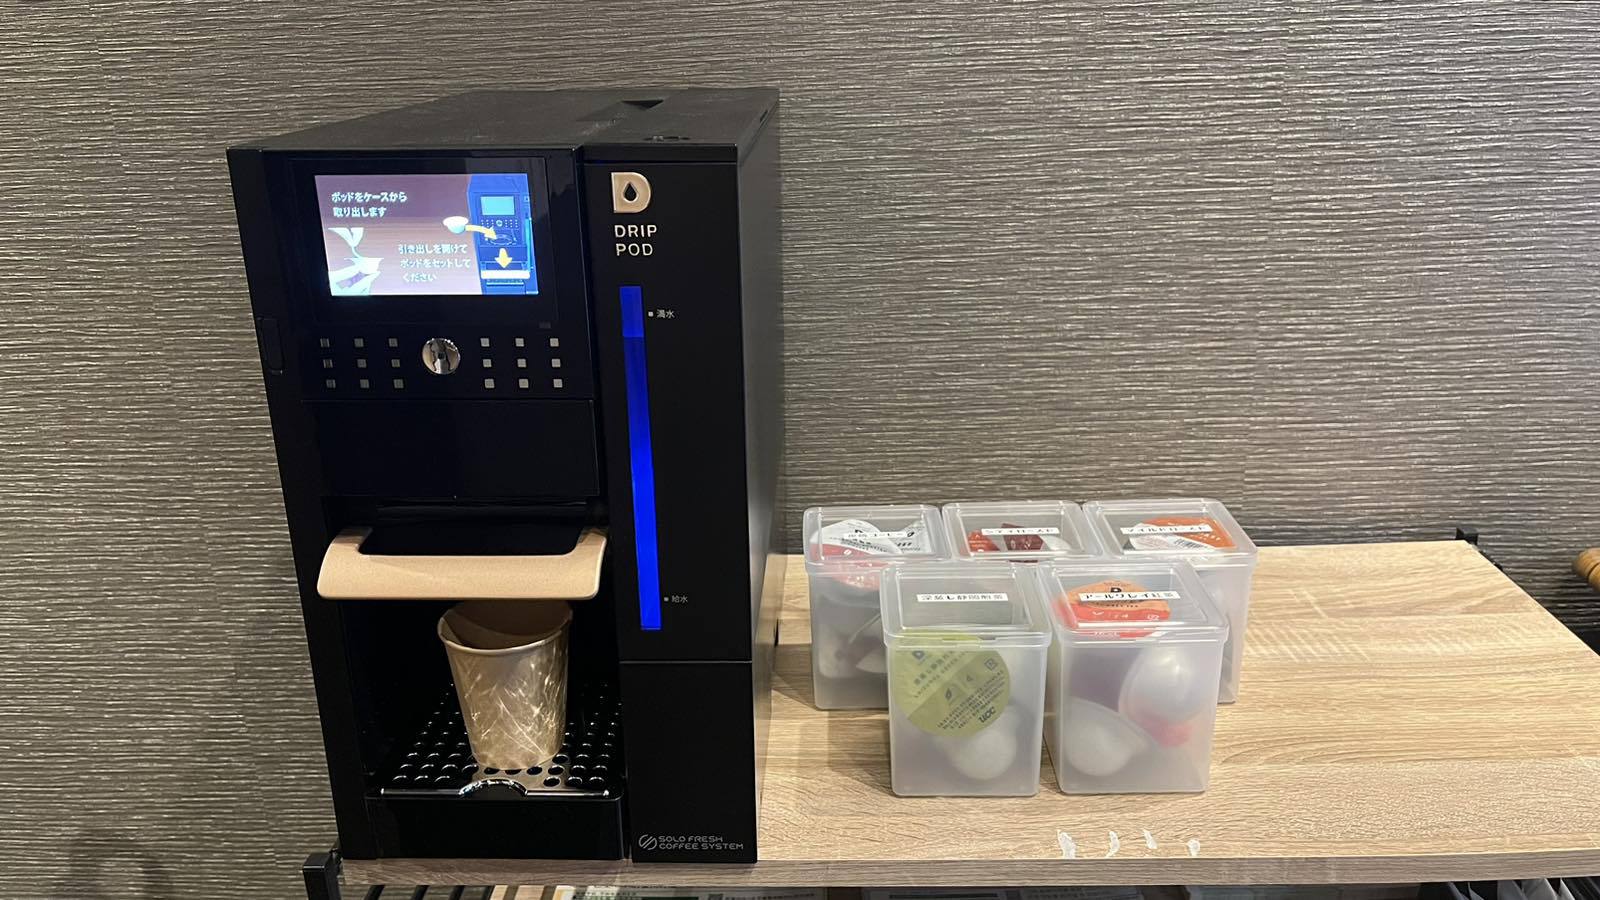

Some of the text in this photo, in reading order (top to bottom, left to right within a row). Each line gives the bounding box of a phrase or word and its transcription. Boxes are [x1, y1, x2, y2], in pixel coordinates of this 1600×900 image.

[331, 191, 407, 202] ポッドをケースから
[333, 206, 387, 217] 取り出します
[614, 225, 657, 238] DRIP
[397, 243, 468, 255] 引き出しを開けて
[616, 243, 653, 256] POD
[400, 258, 471, 269] ポッドをセットして
[402, 272, 437, 282] ください
[658, 835, 723, 843] SOLO FRESH
[658, 842, 744, 850] COFFEE SYSTEM
